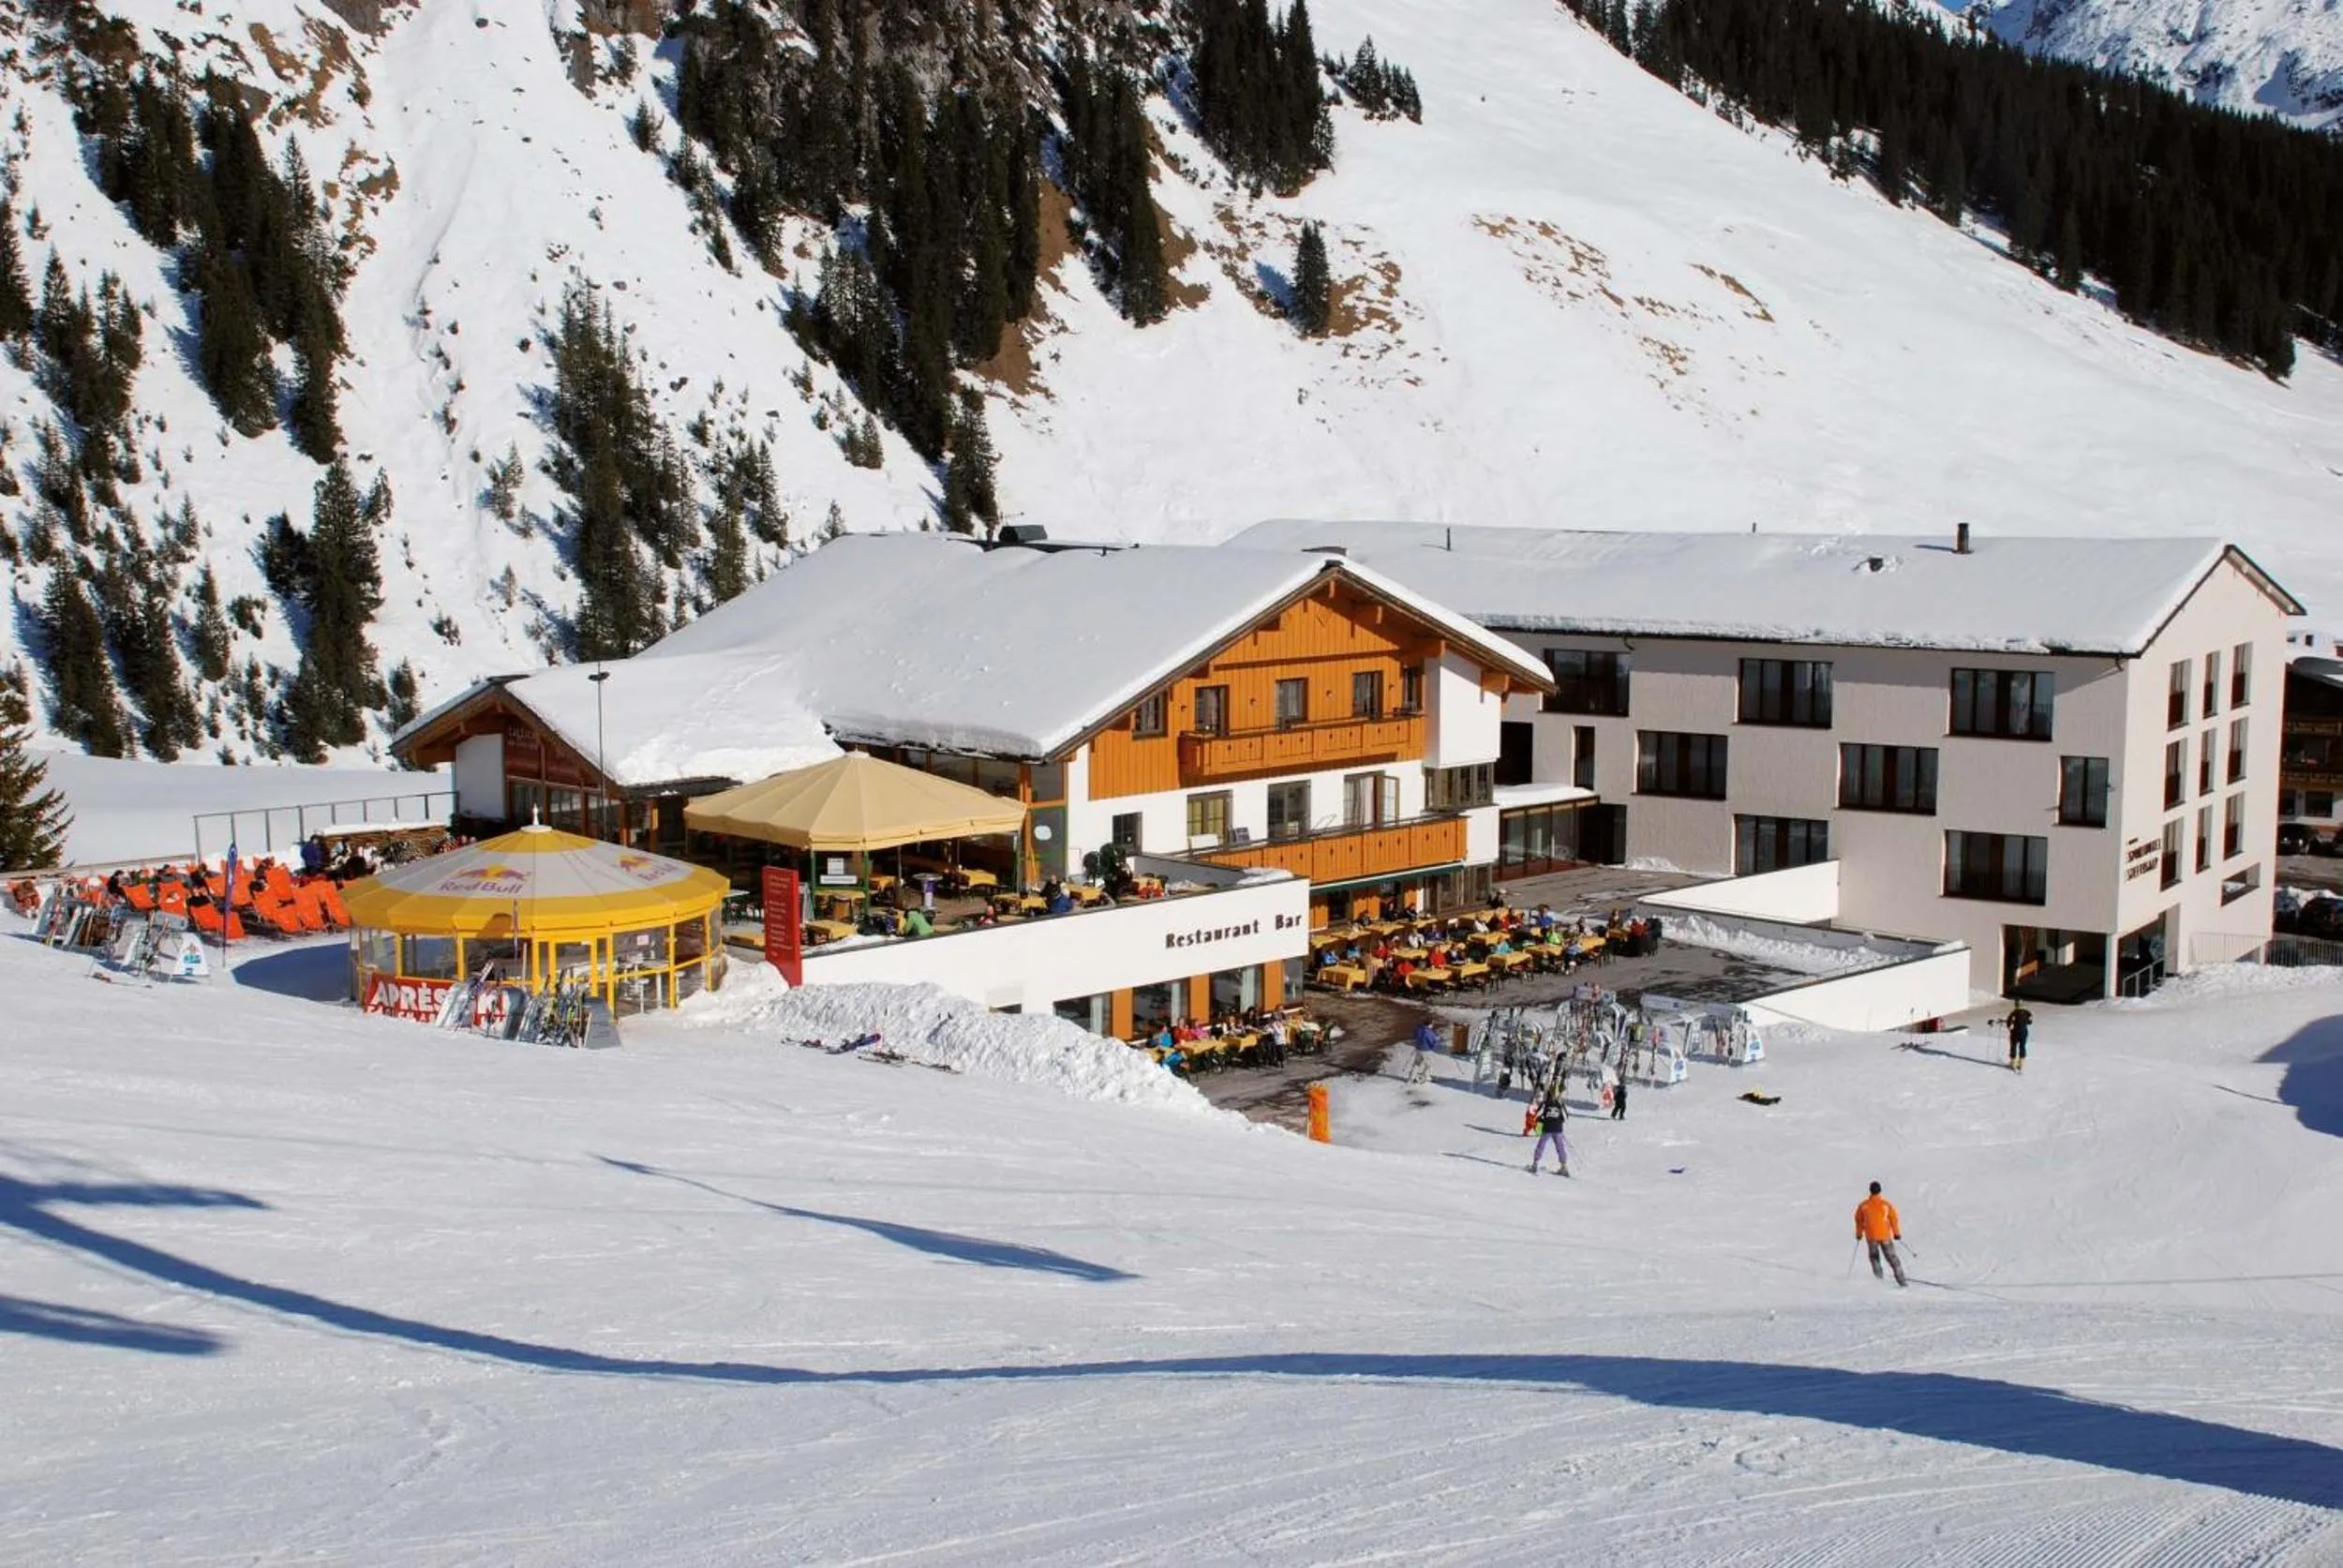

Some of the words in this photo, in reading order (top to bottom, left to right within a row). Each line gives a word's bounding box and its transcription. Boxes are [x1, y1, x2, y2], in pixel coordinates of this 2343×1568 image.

[481, 882, 523, 894] Bull
[1165, 918, 1260, 948] Restaurant
[1275, 914, 1303, 931] Bar
